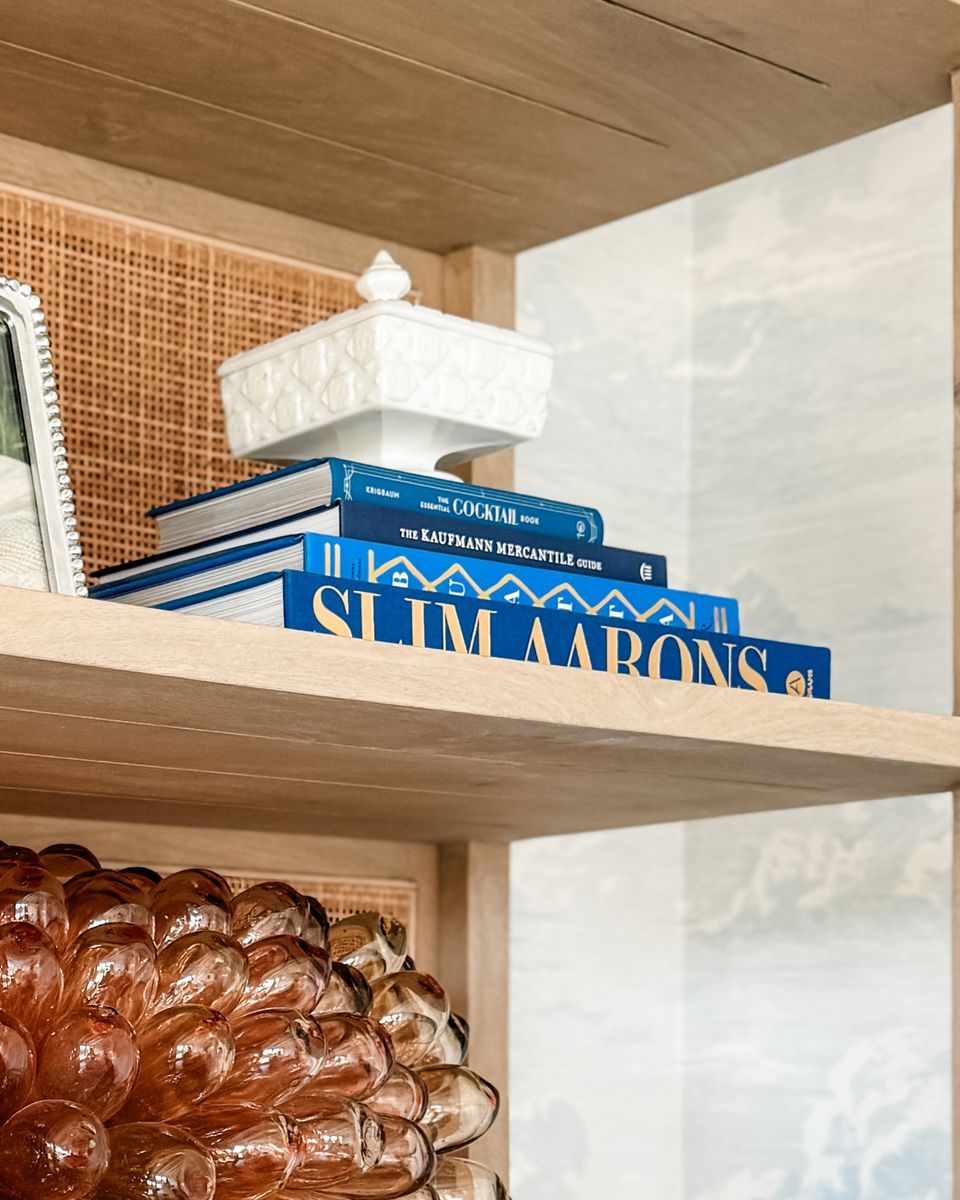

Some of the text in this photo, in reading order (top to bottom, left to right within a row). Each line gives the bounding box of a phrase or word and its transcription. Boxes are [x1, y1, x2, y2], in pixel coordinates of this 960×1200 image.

[365, 486, 400, 499] KRIGBAUM
[420, 498, 540, 526] ESSENTIAL COCKTAIL BOOK
[400, 528, 603, 571] THE KAUFMANN MERCANTILE GUIDE
[312, 584, 768, 694] SLIM AARONS
